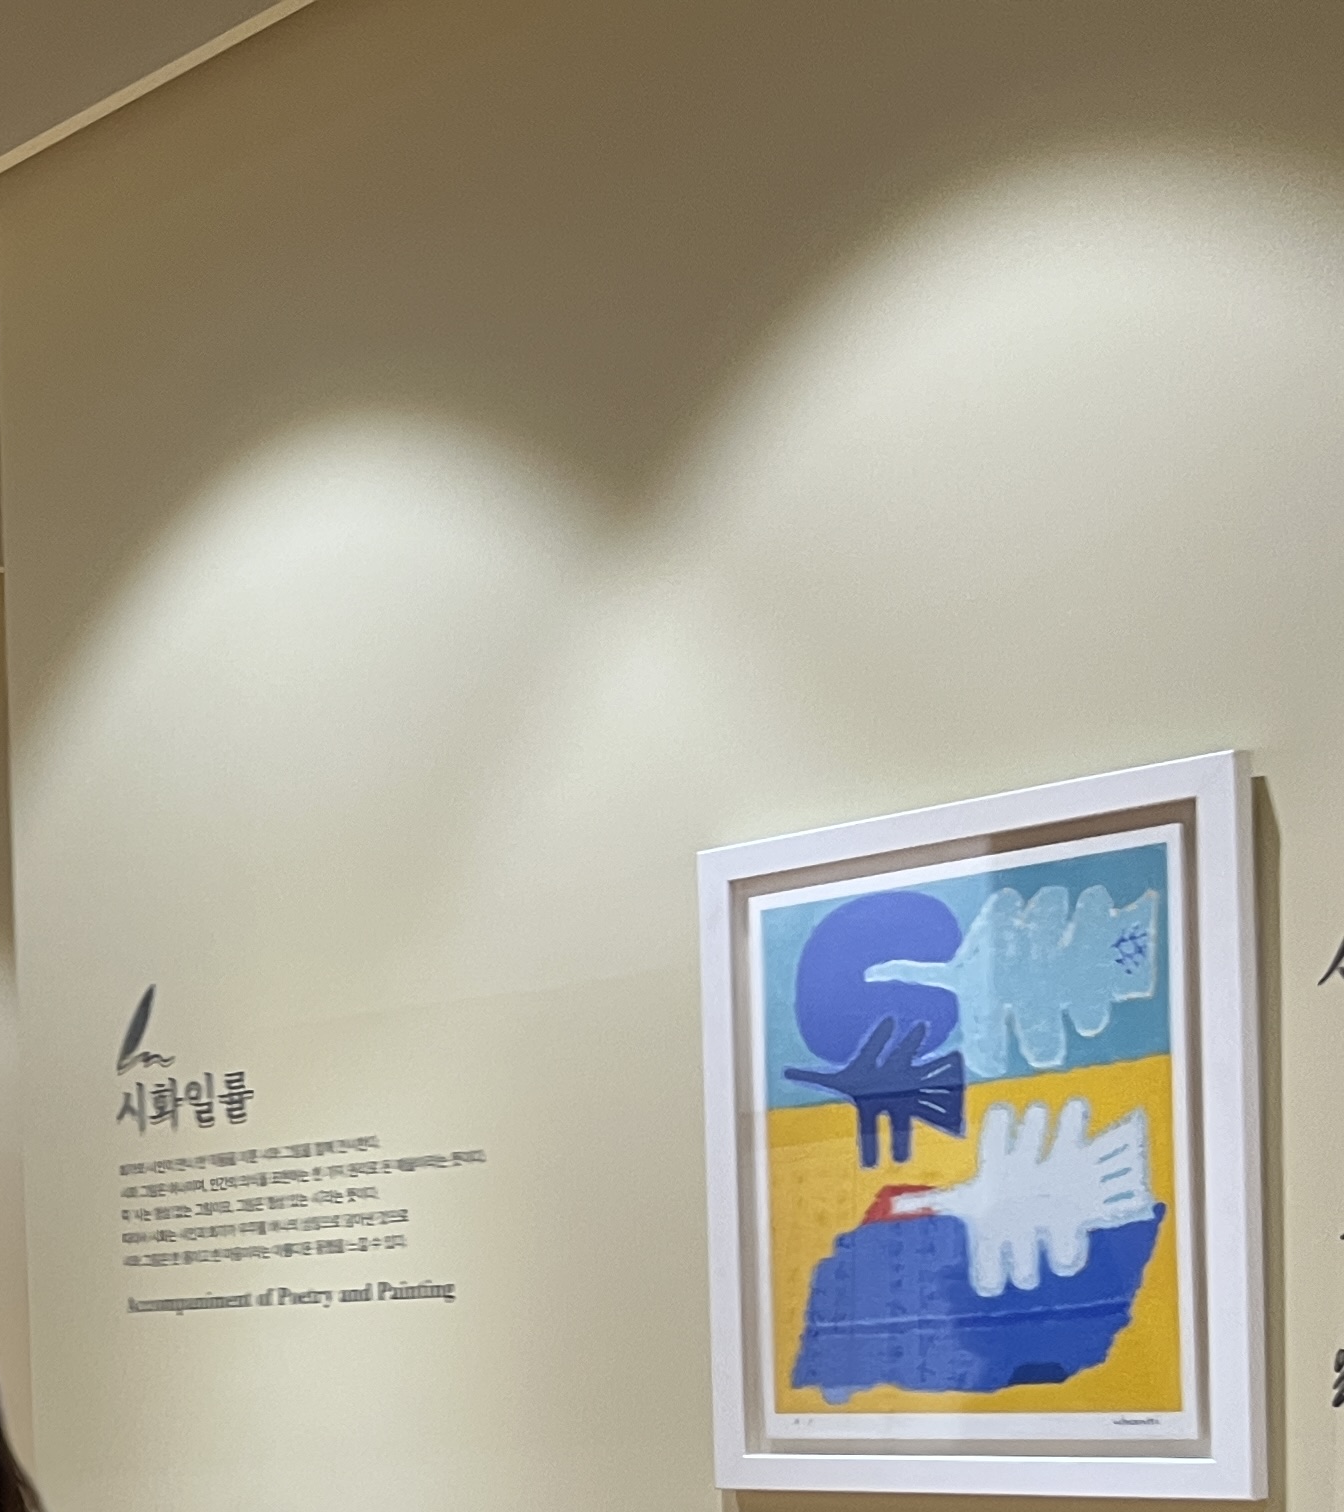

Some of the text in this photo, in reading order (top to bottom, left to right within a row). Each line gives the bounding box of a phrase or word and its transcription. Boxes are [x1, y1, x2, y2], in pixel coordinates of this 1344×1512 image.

[115, 1071, 255, 1135] 시화일률
[257, 1287, 275, 1306] of
[277, 1287, 333, 1308] Poetry
[339, 1282, 373, 1302] and
[377, 1280, 455, 1304] Painting
